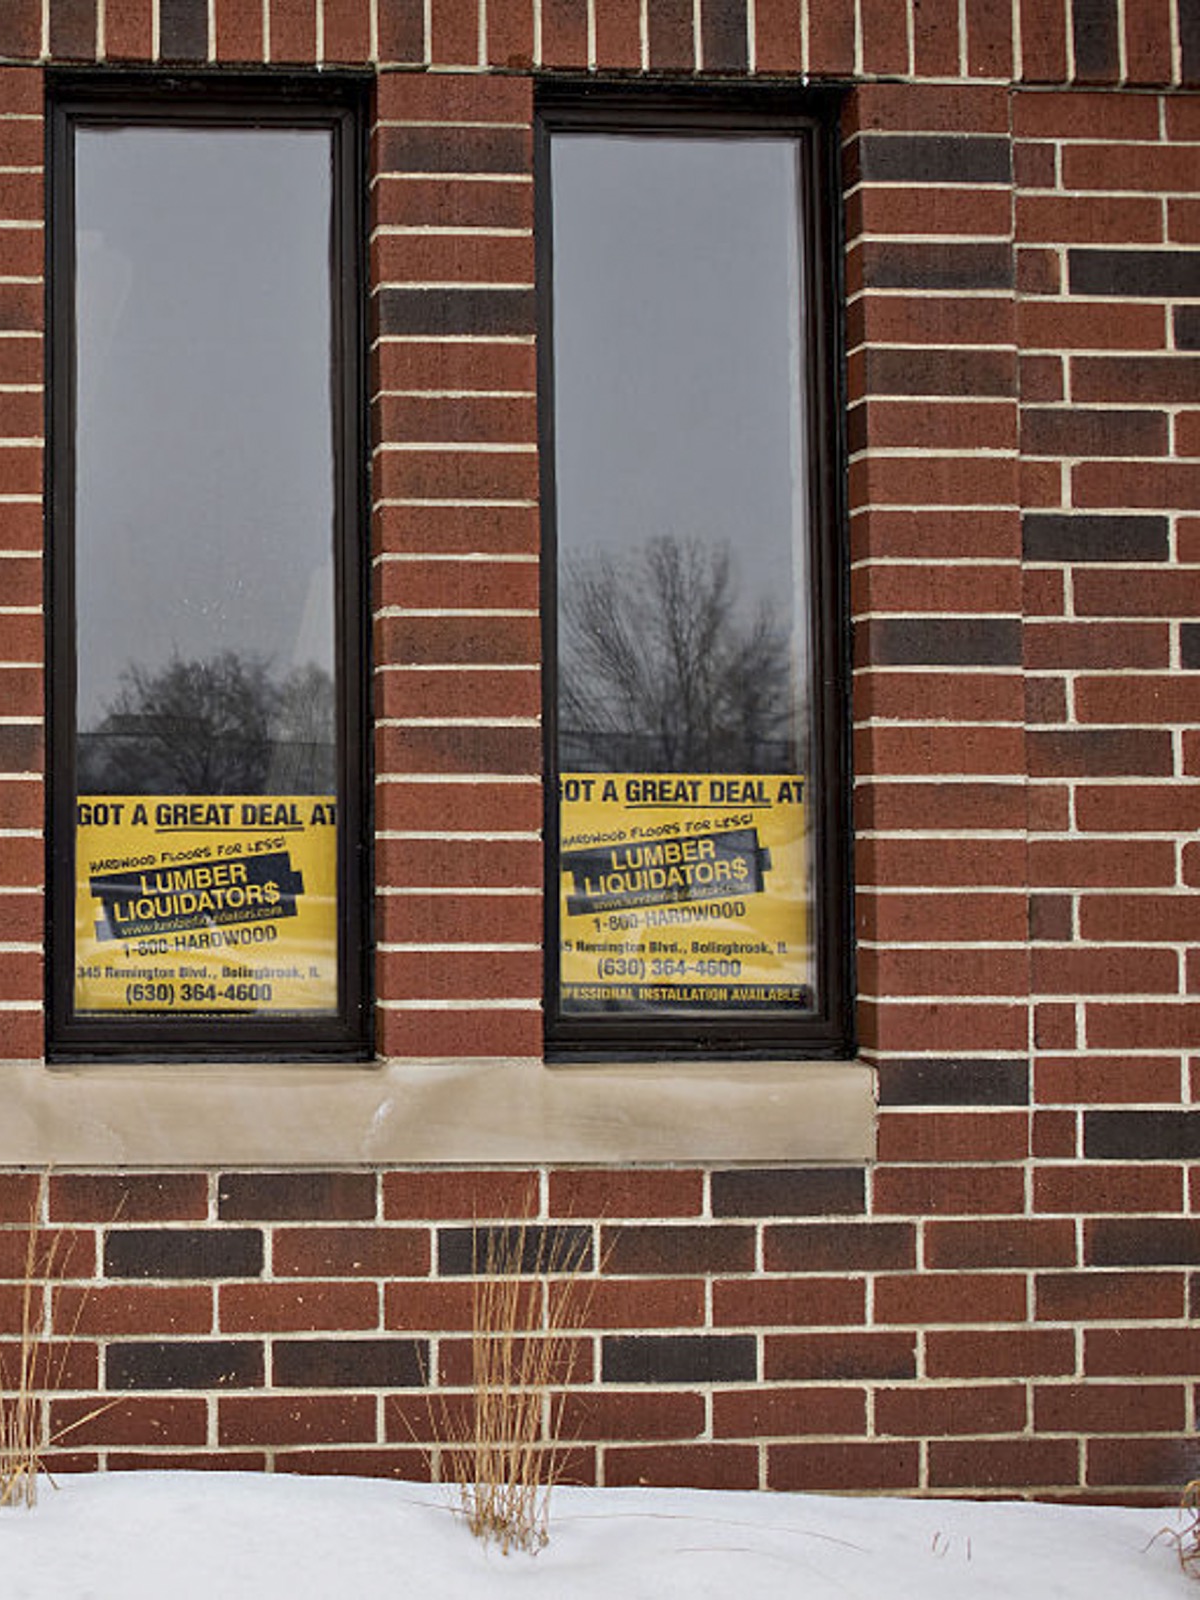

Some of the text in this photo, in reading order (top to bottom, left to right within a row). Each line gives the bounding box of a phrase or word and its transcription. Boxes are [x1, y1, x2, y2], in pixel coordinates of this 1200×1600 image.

[603, 780, 618, 801] A
[626, 780, 701, 802] GREAT
[710, 781, 771, 802] DEAL
[778, 782, 804, 803] AT
[77, 804, 337, 825] GOT A GREAT DEAL AT
[631, 823, 680, 838] FLOORS
[686, 820, 710, 832] FOR
[89, 856, 156, 873] HARDWOOD
[161, 848, 211, 863] FLOORS
[217, 844, 242, 856] FOR
[612, 839, 716, 870] LUMBER
[141, 863, 248, 896] LUMBER
[593, 902, 746, 932] 1-800-HARDWOOD
[123, 925, 277, 958] 1-800-HARDWOOD
[77, 966, 101, 979] 345
[598, 958, 741, 979] (630) 364-4600
[126, 983, 272, 1005] (630) 364-4600
[639, 987, 727, 1001] INSTALLATION
